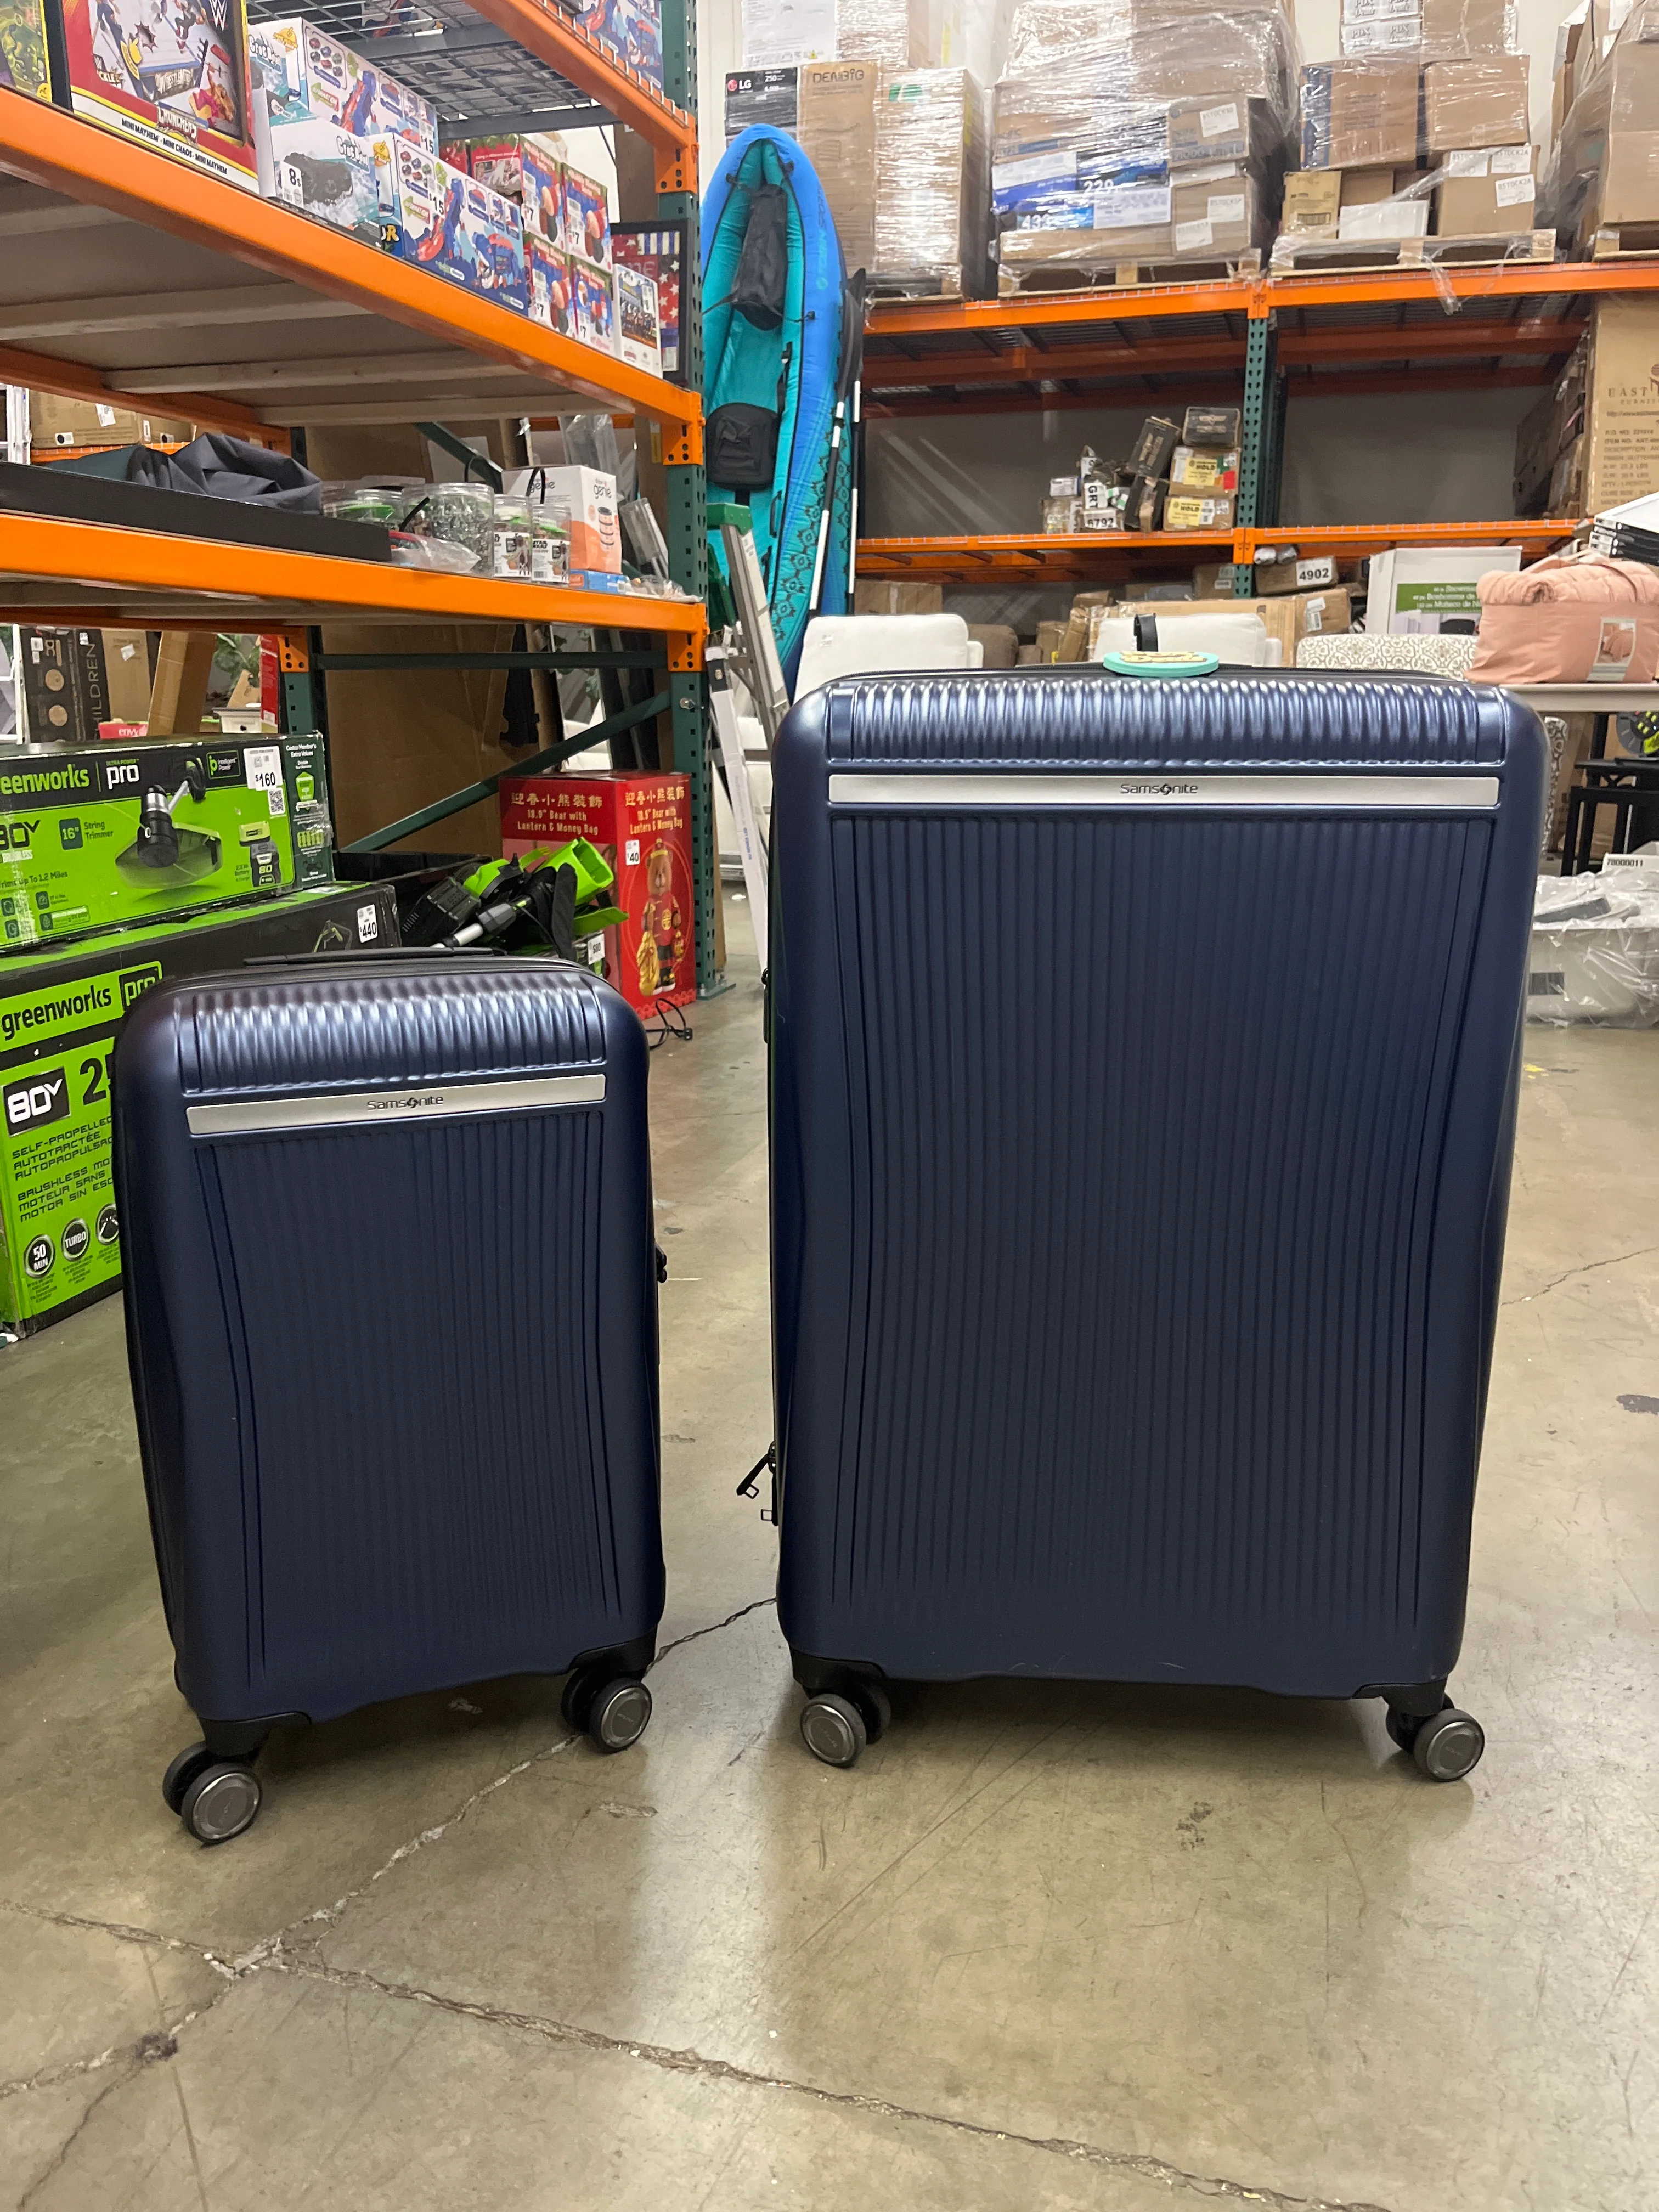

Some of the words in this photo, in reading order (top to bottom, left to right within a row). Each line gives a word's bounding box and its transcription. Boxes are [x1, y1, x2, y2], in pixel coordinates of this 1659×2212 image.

[739, 80, 751, 89] LG
[122, 118, 134, 131] MINI
[134, 125, 159, 143] MAYHEM
[163, 138, 175, 149] MINI
[176, 144, 192, 158] CHAOS
[195, 153, 206, 165] MINI
[206, 159, 227, 174] MAYHEM
[1609, 387, 1647, 397] EAST
[1299, 568, 1329, 580] 4902
[0, 764, 90, 795] eenworks
[106, 765, 139, 789] pro
[256, 772, 275, 787] $160
[1120, 783, 1198, 795] Samsonite
[550, 810, 567, 820] Bear
[569, 811, 586, 821] with
[62, 827, 80, 840] 16"
[84, 822, 105, 830] String
[517, 821, 546, 831] Lantern
[557, 822, 582, 835] Money
[584, 824, 598, 836] Bag
[84, 831, 114, 840] Trimmer
[259, 864, 273, 874] 80
[0, 880, 16, 888] rims
[50, 871, 68, 879] Miles
[359, 922, 377, 938] $440
[2, 985, 112, 1041] greenworks
[8, 1079, 63, 1124] 80V
[367, 1096, 444, 1110] Samsonite
[14, 1131, 101, 1170] AUTOTRACTÉE
[18, 1166, 88, 1201] BRUSHLESS
[93, 1156, 112, 1171] MO
[19, 1185, 69, 1212] MOTEUR
[76, 1170, 105, 1188] SANS
[20, 1199, 63, 1222] MOTOR
[69, 1188, 87, 1201] SIN
[65, 1231, 86, 1248] TURBO
[33, 1244, 46, 1260] 50
[33, 1257, 48, 1271] MIN
